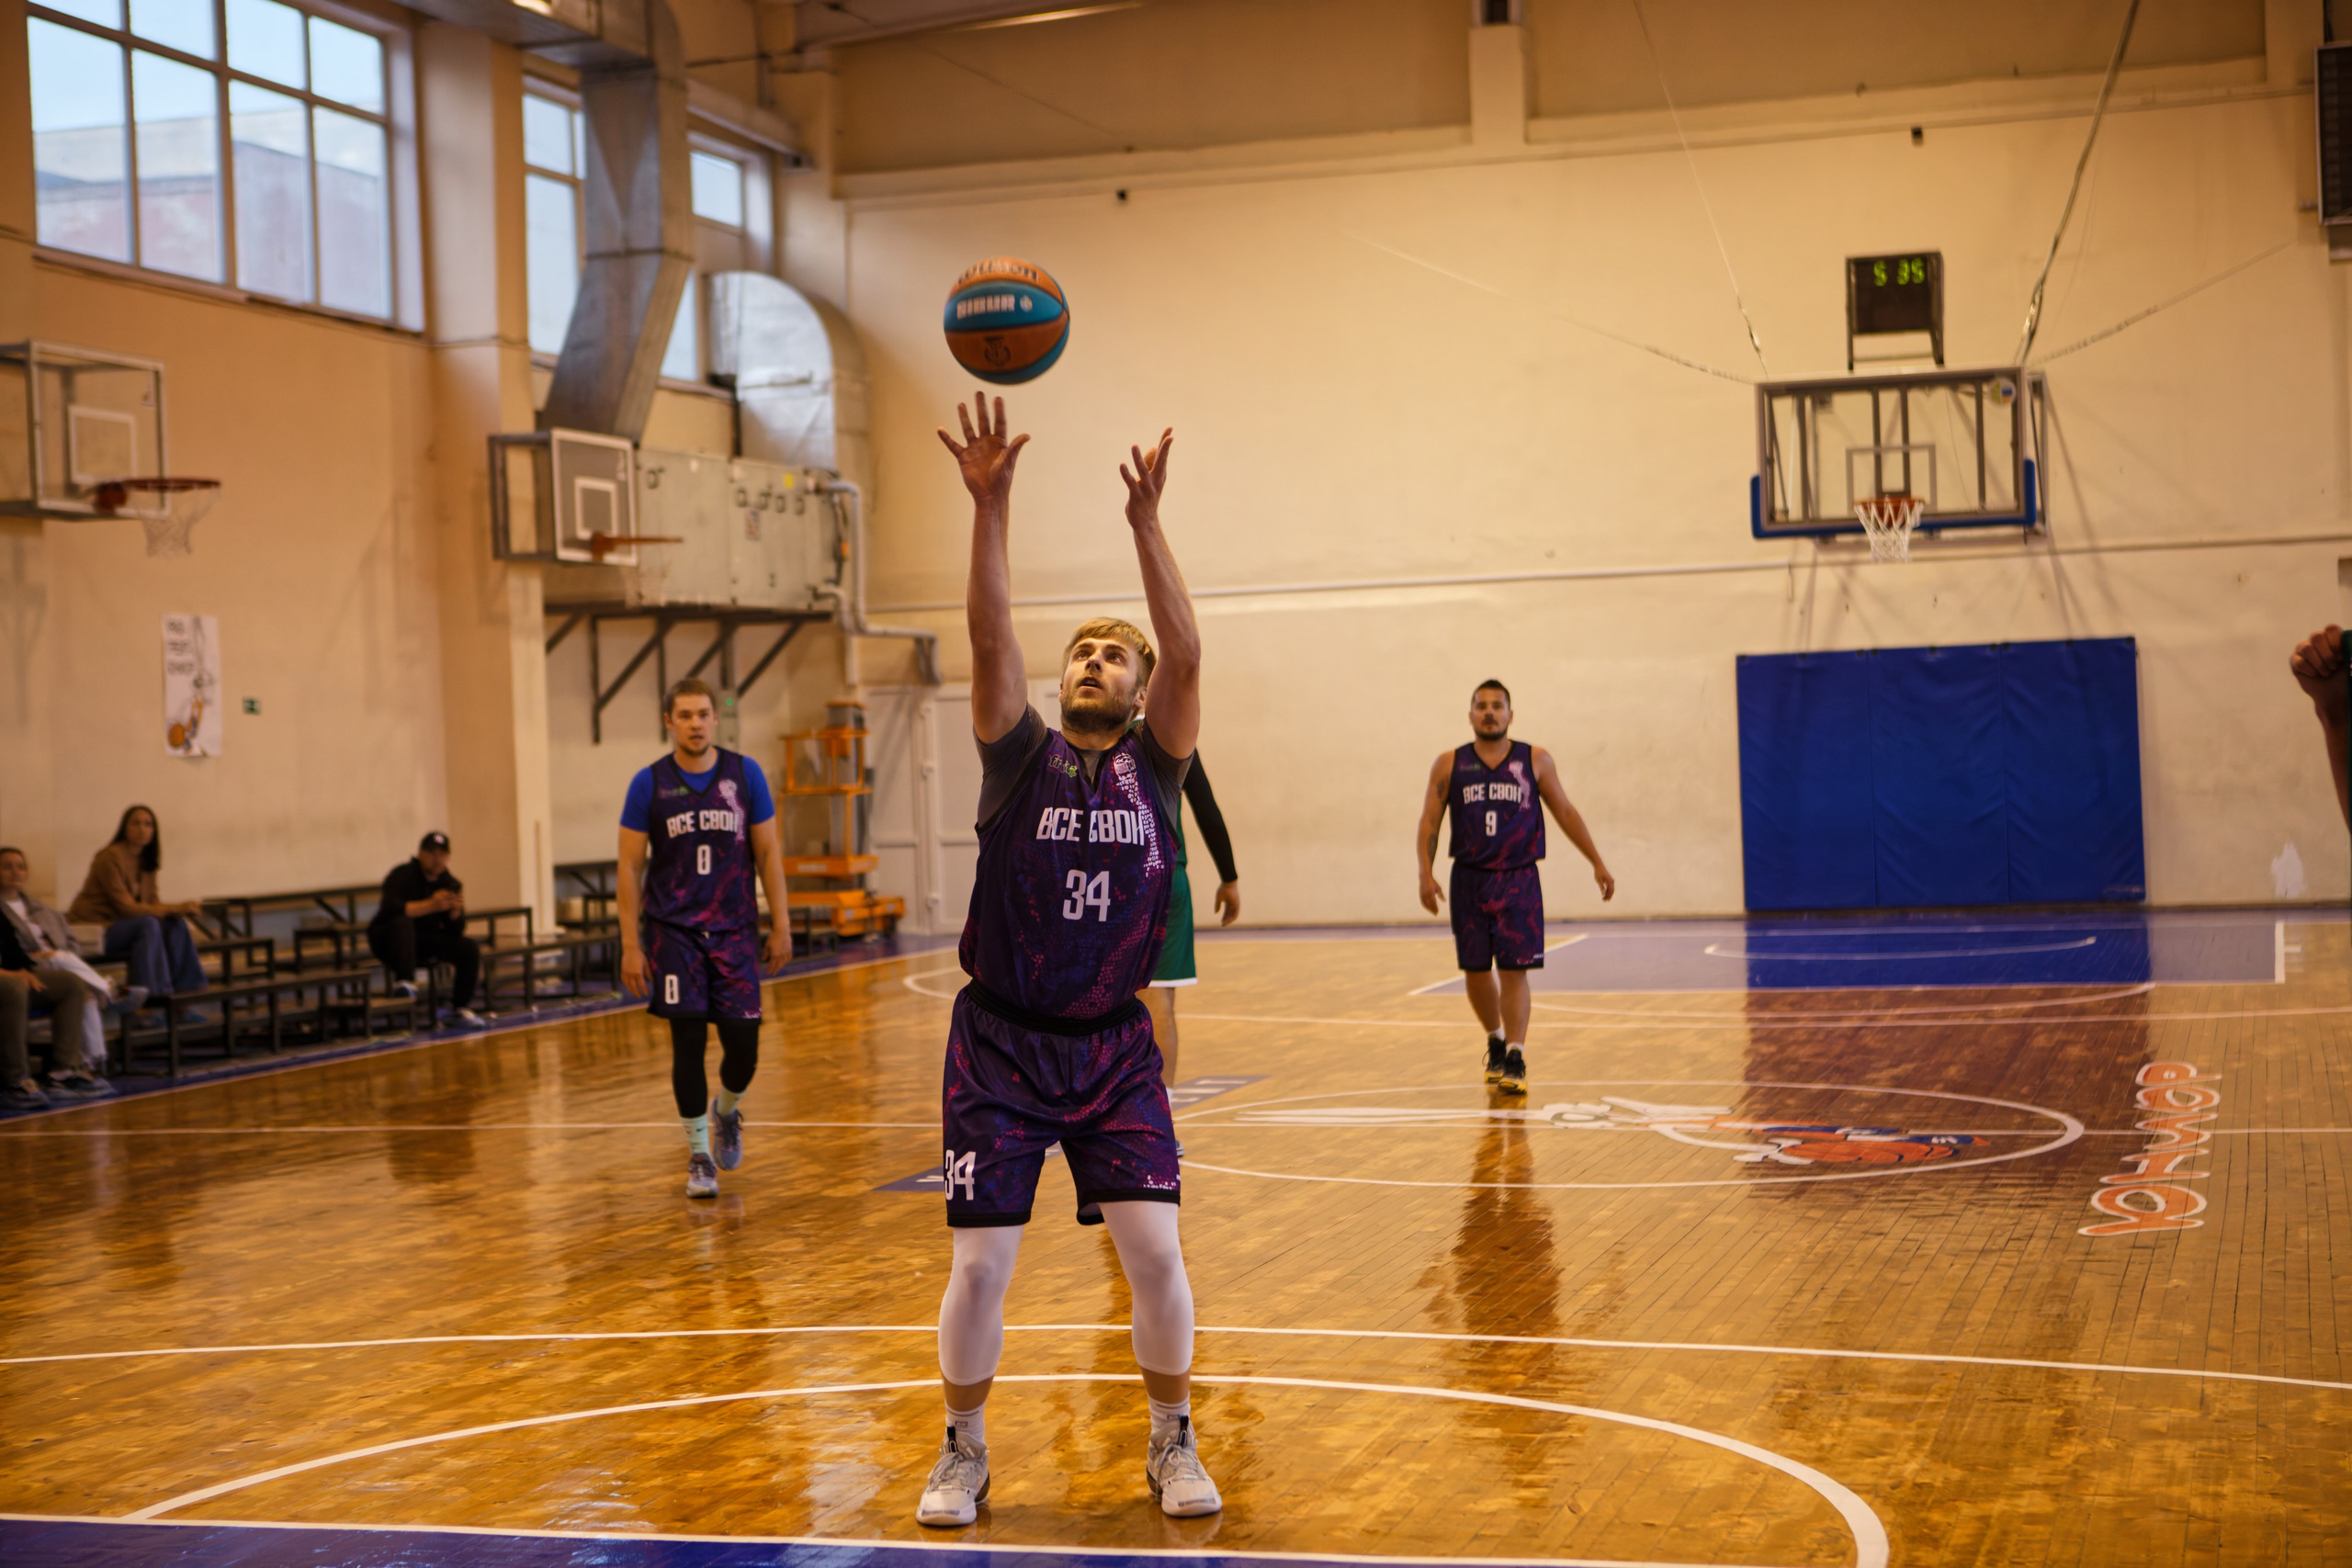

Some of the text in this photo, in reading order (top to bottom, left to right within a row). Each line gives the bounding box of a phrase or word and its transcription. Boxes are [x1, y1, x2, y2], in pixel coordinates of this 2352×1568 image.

[1463, 783, 1486, 805] ВСЕ
[666, 811, 695, 839] ВСЕ
[1035, 807, 1083, 842] ВСЕ
[1486, 810, 1497, 837] 9
[696, 844, 711, 875] 0
[1062, 869, 1111, 922] 34
[944, 1149, 977, 1201] 34
